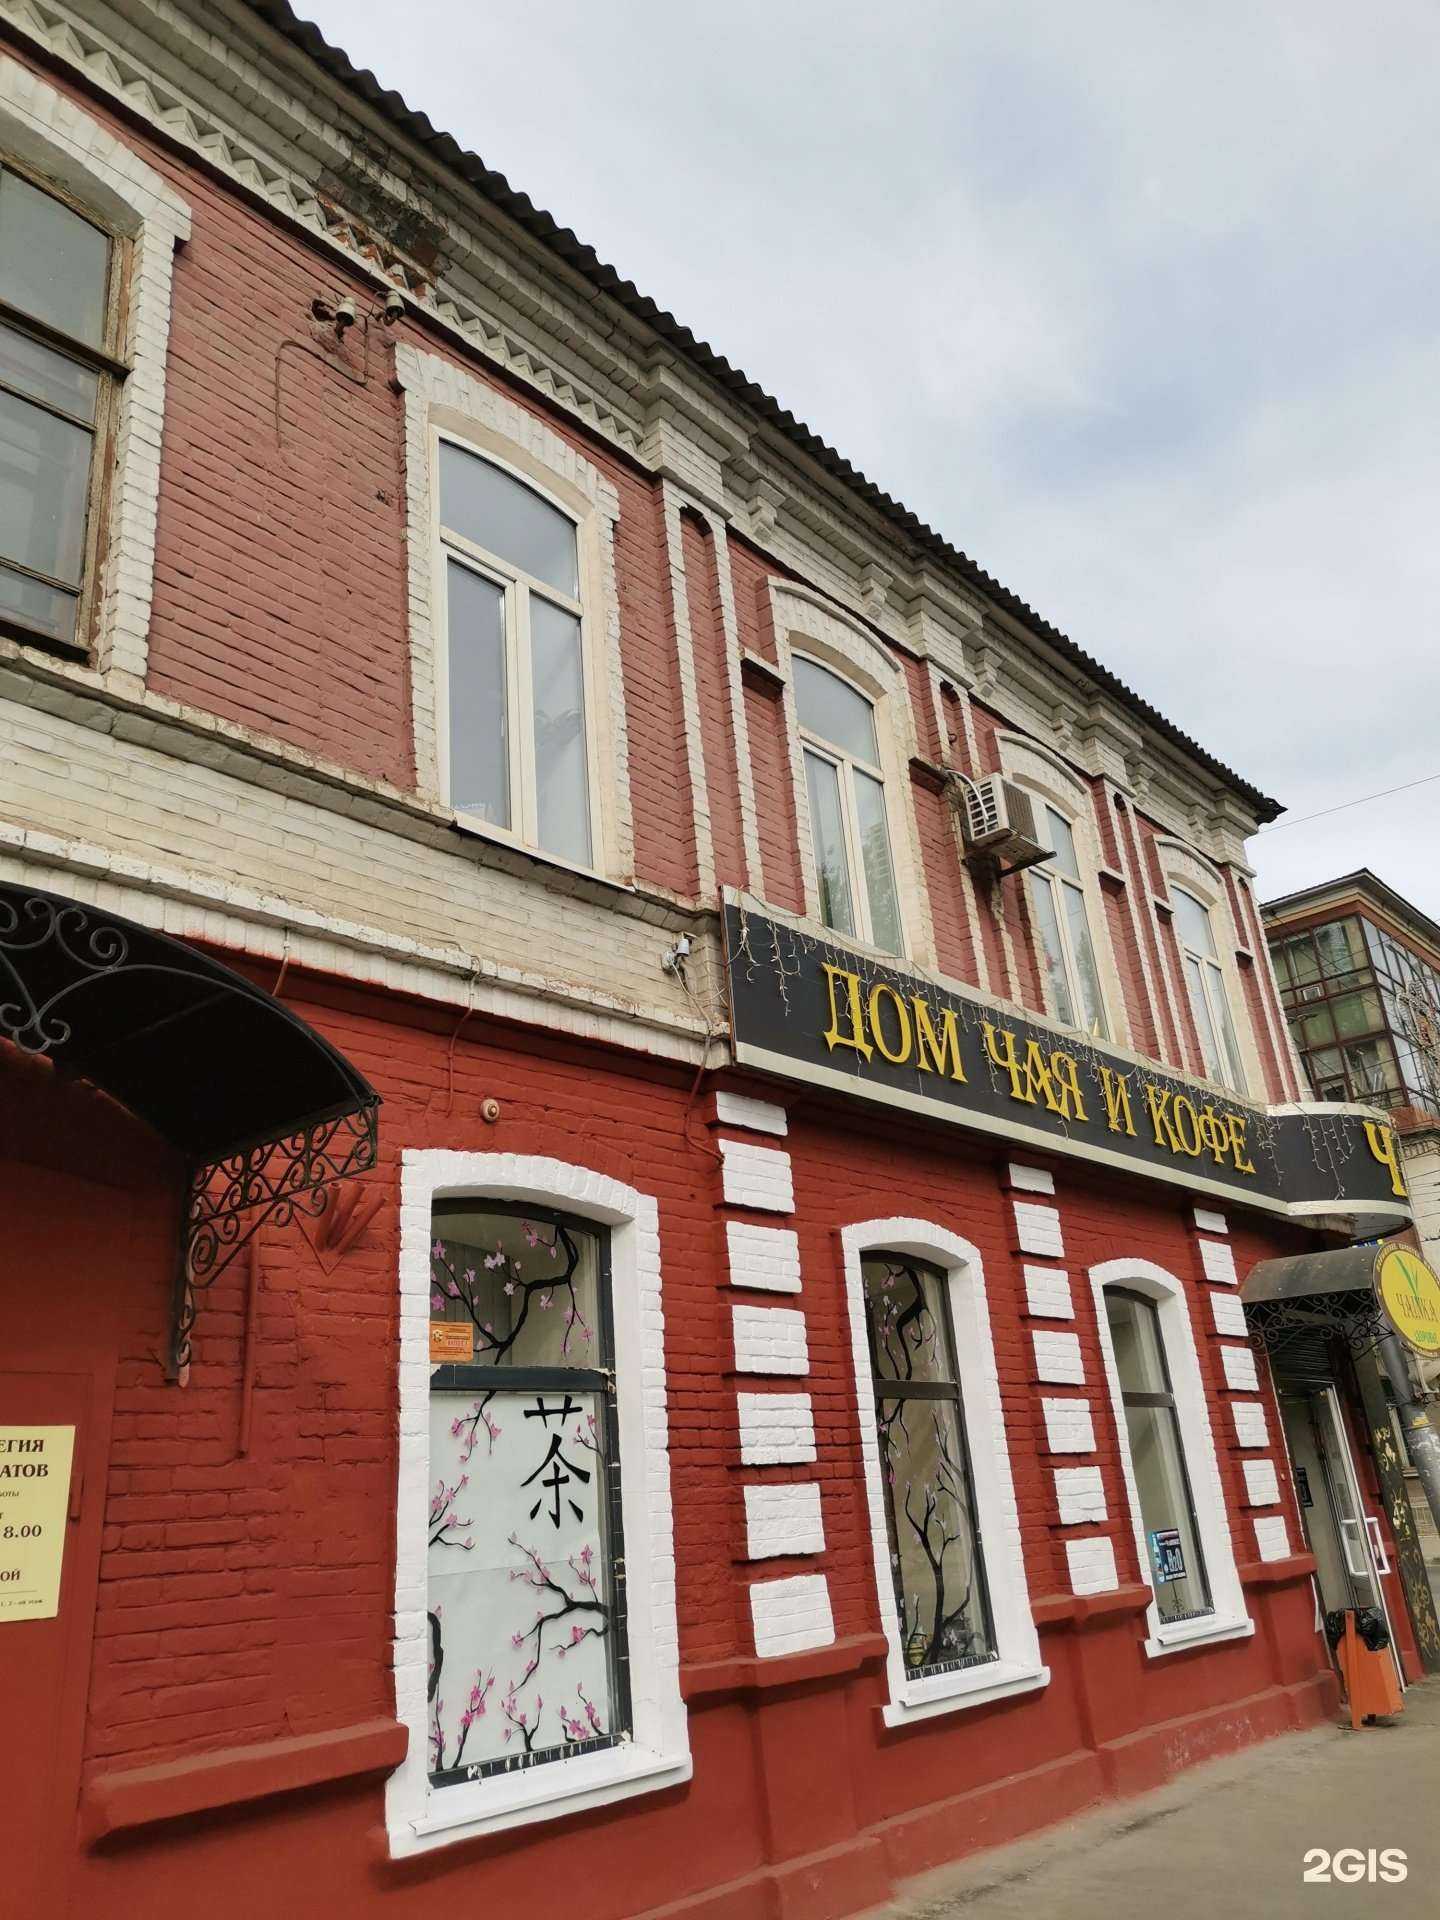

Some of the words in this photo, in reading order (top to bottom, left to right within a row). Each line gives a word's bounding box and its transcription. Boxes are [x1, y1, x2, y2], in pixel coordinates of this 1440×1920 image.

[821, 961, 968, 1083] ДОМ
[982, 1020, 1090, 1121] ЧАЯ
[1099, 1066, 1138, 1136] И
[1144, 1084, 1257, 1174] КОФЕ
[520, 1394, 591, 1530] 茶
